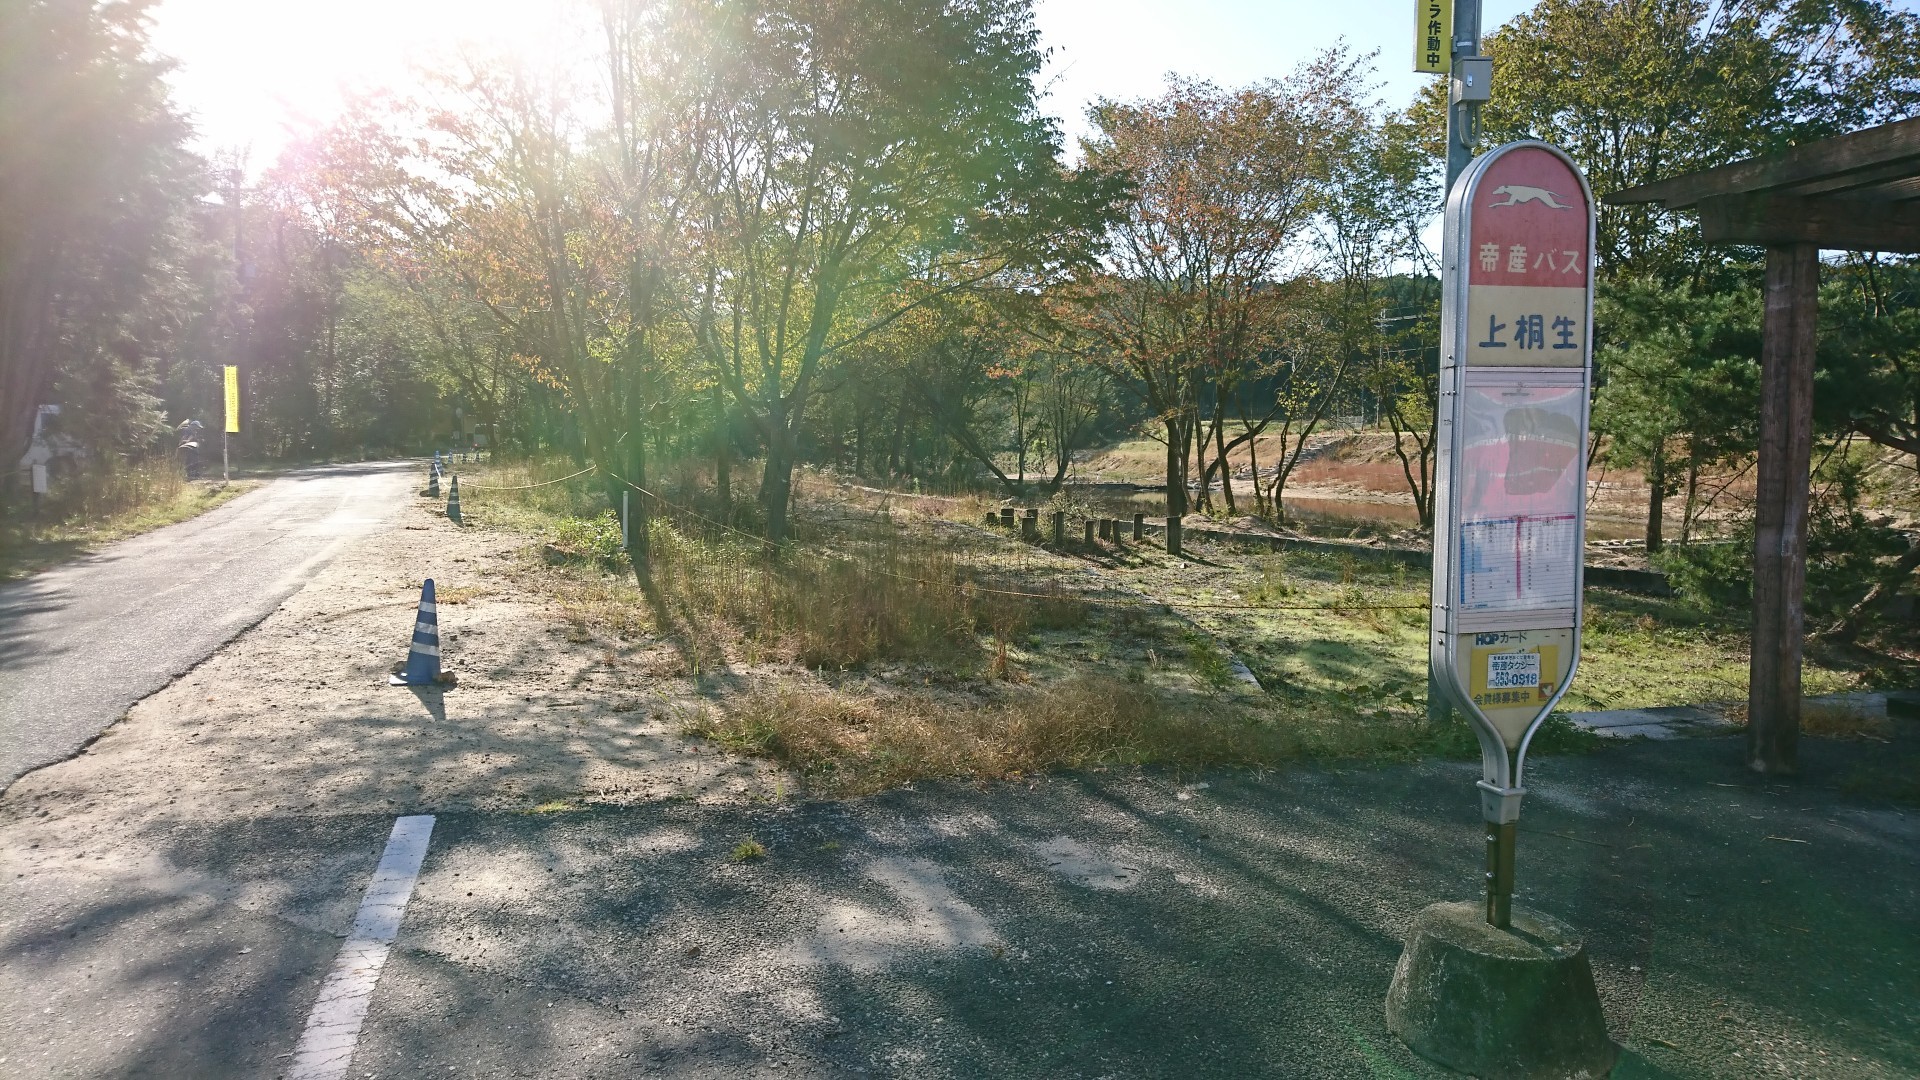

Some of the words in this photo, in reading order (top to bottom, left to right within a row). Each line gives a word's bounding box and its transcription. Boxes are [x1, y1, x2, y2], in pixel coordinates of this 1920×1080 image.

[1427, 0, 1441, 67] ラ作動中
[1480, 242, 1583, 275] 帝産バス
[1478, 314, 1578, 350] 上桐生
[1492, 661, 1535, 671] 帝産タクシー
